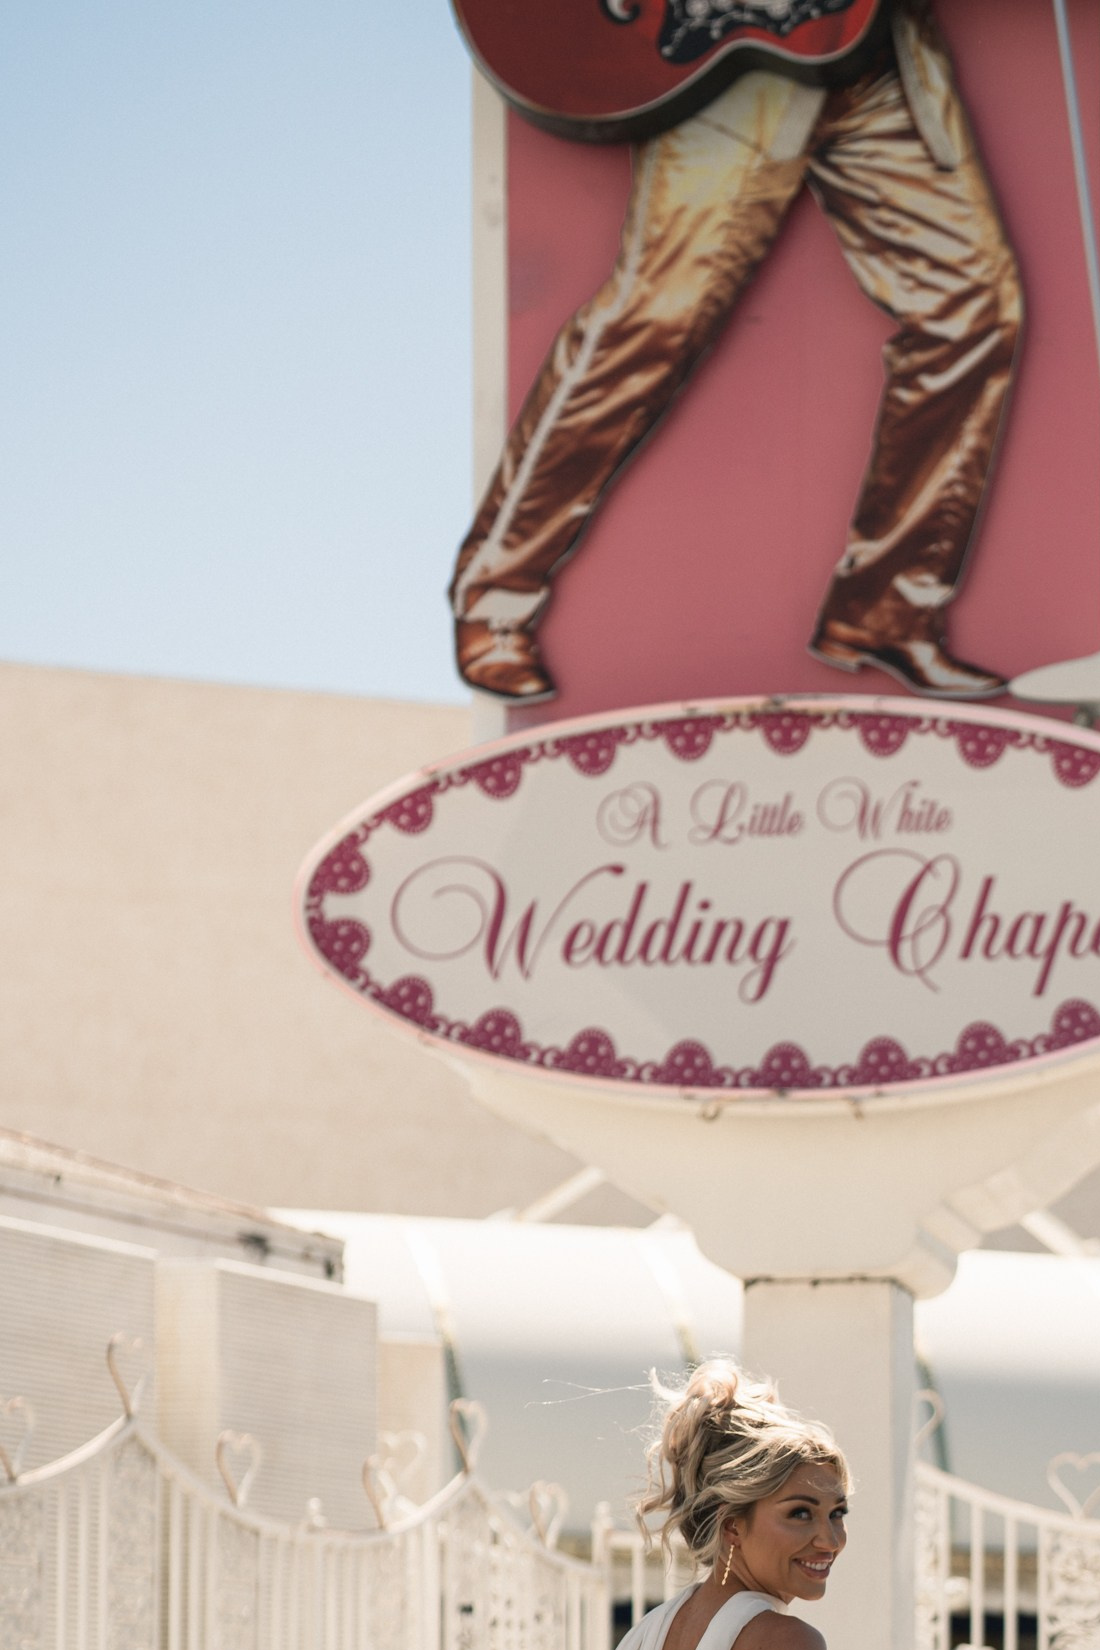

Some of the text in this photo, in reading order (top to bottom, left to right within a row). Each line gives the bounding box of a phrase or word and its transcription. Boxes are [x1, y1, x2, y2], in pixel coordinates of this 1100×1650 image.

[597, 775, 954, 851] A Little White
[388, 854, 796, 1004] Wedding
